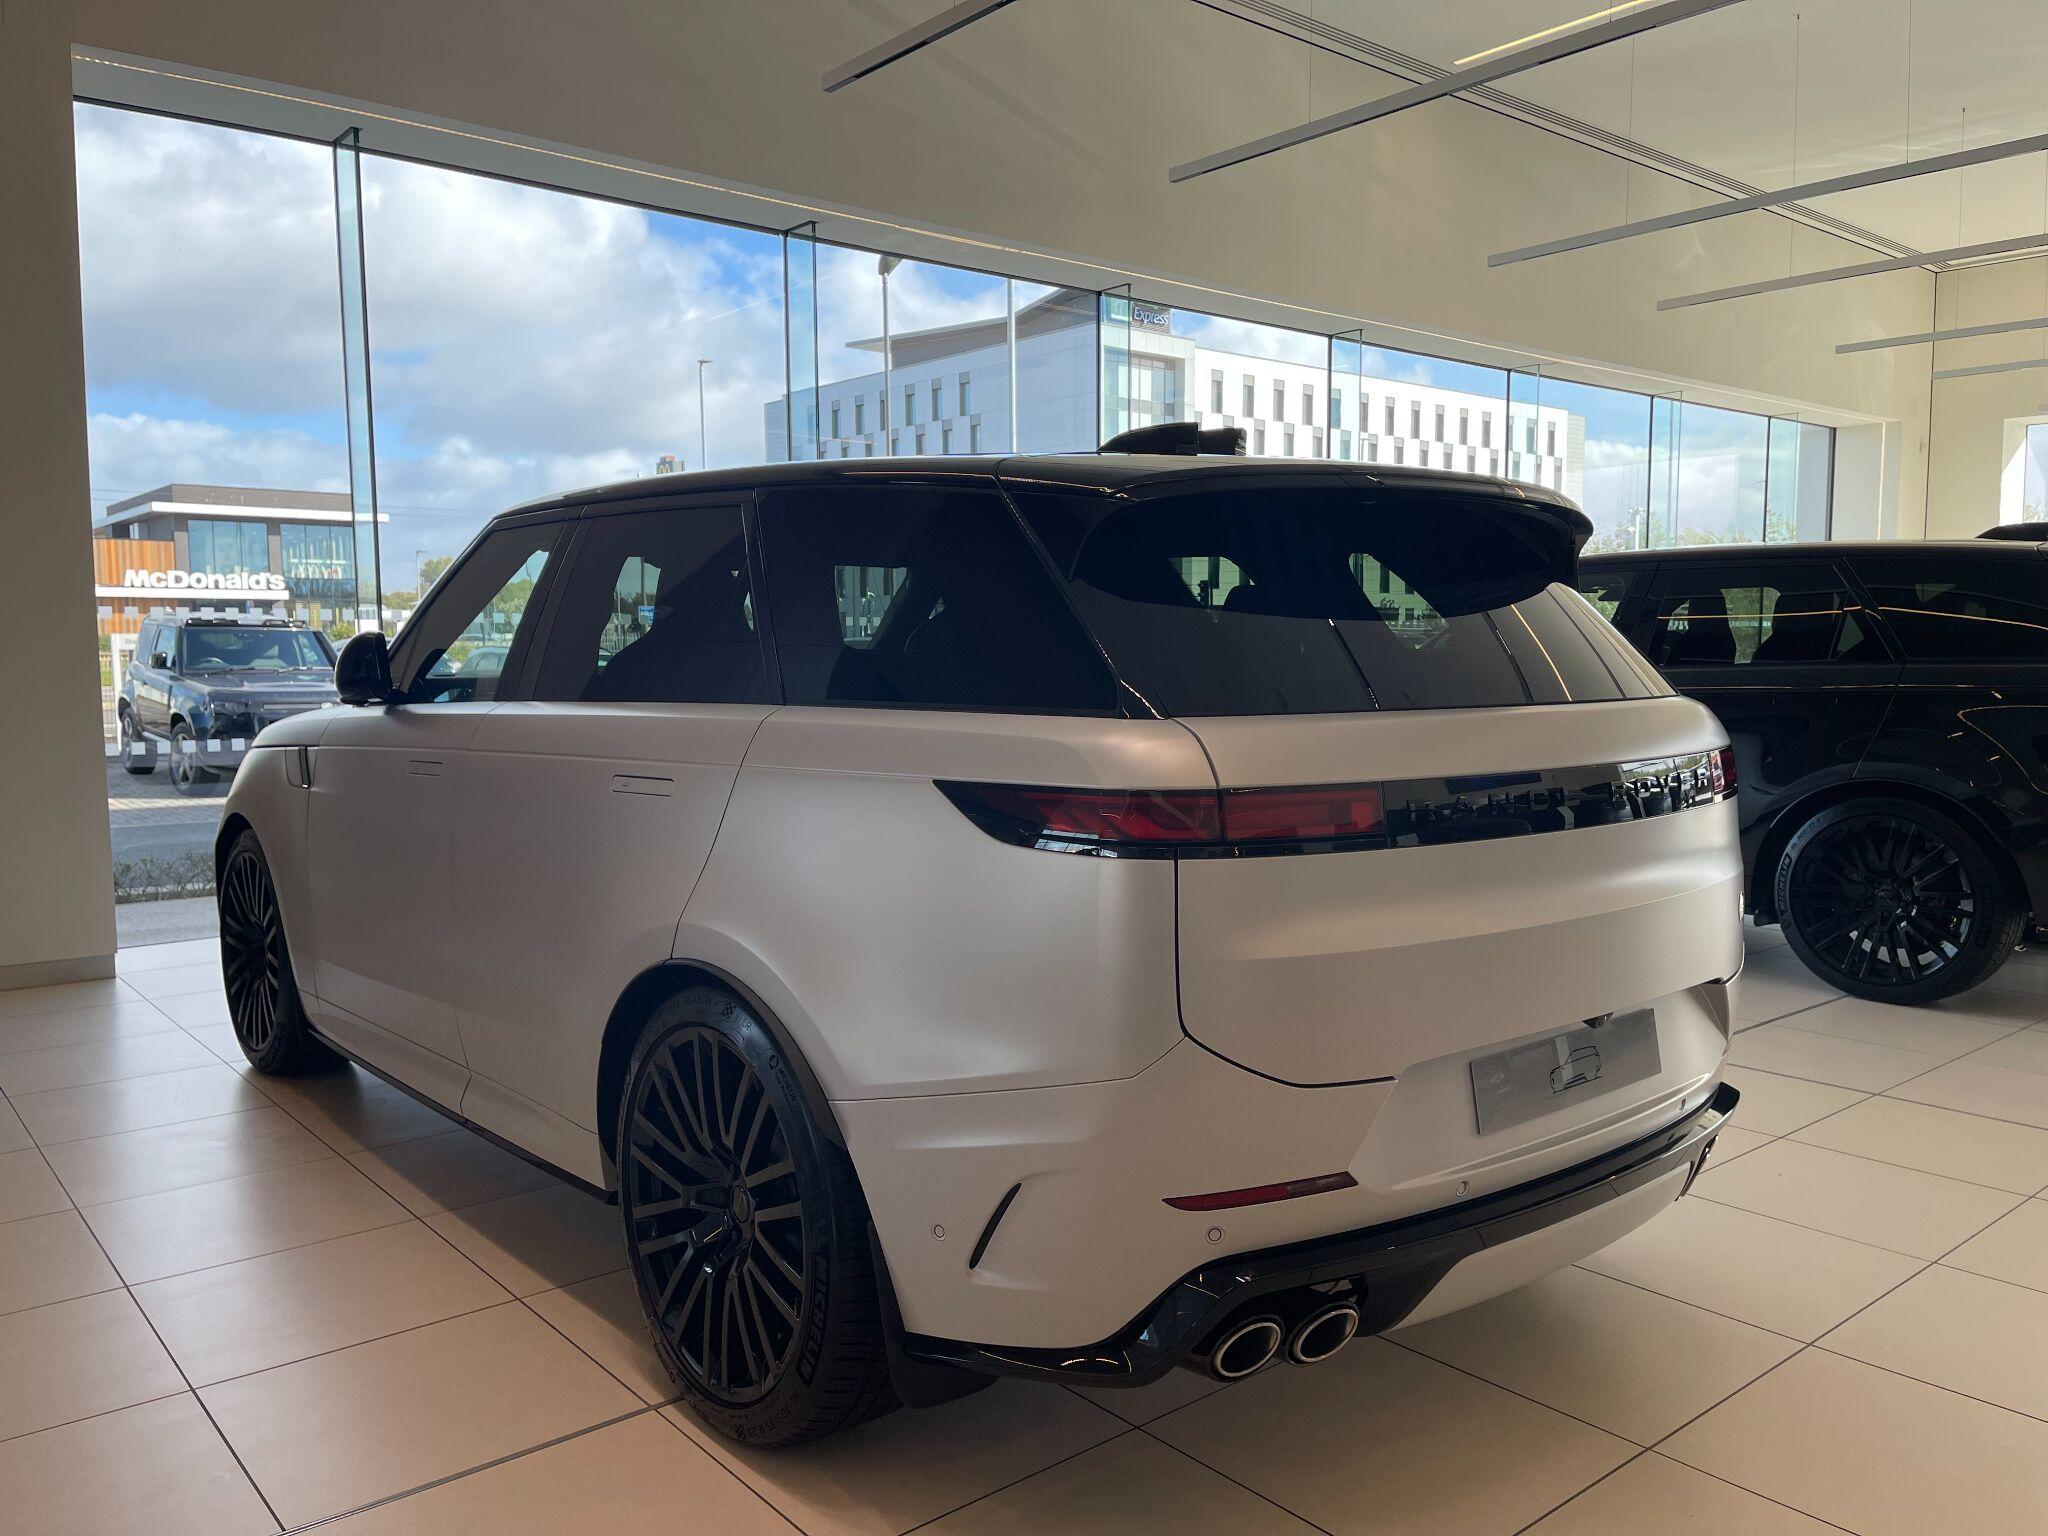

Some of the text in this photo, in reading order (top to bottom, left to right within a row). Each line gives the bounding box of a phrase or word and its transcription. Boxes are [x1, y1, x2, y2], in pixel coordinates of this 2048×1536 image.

[1134, 307, 1169, 325] Express
[124, 570, 286, 590] McDonald's
[1407, 767, 1708, 822] RANGE ROVER
[799, 1251, 829, 1386] MICHELIN
